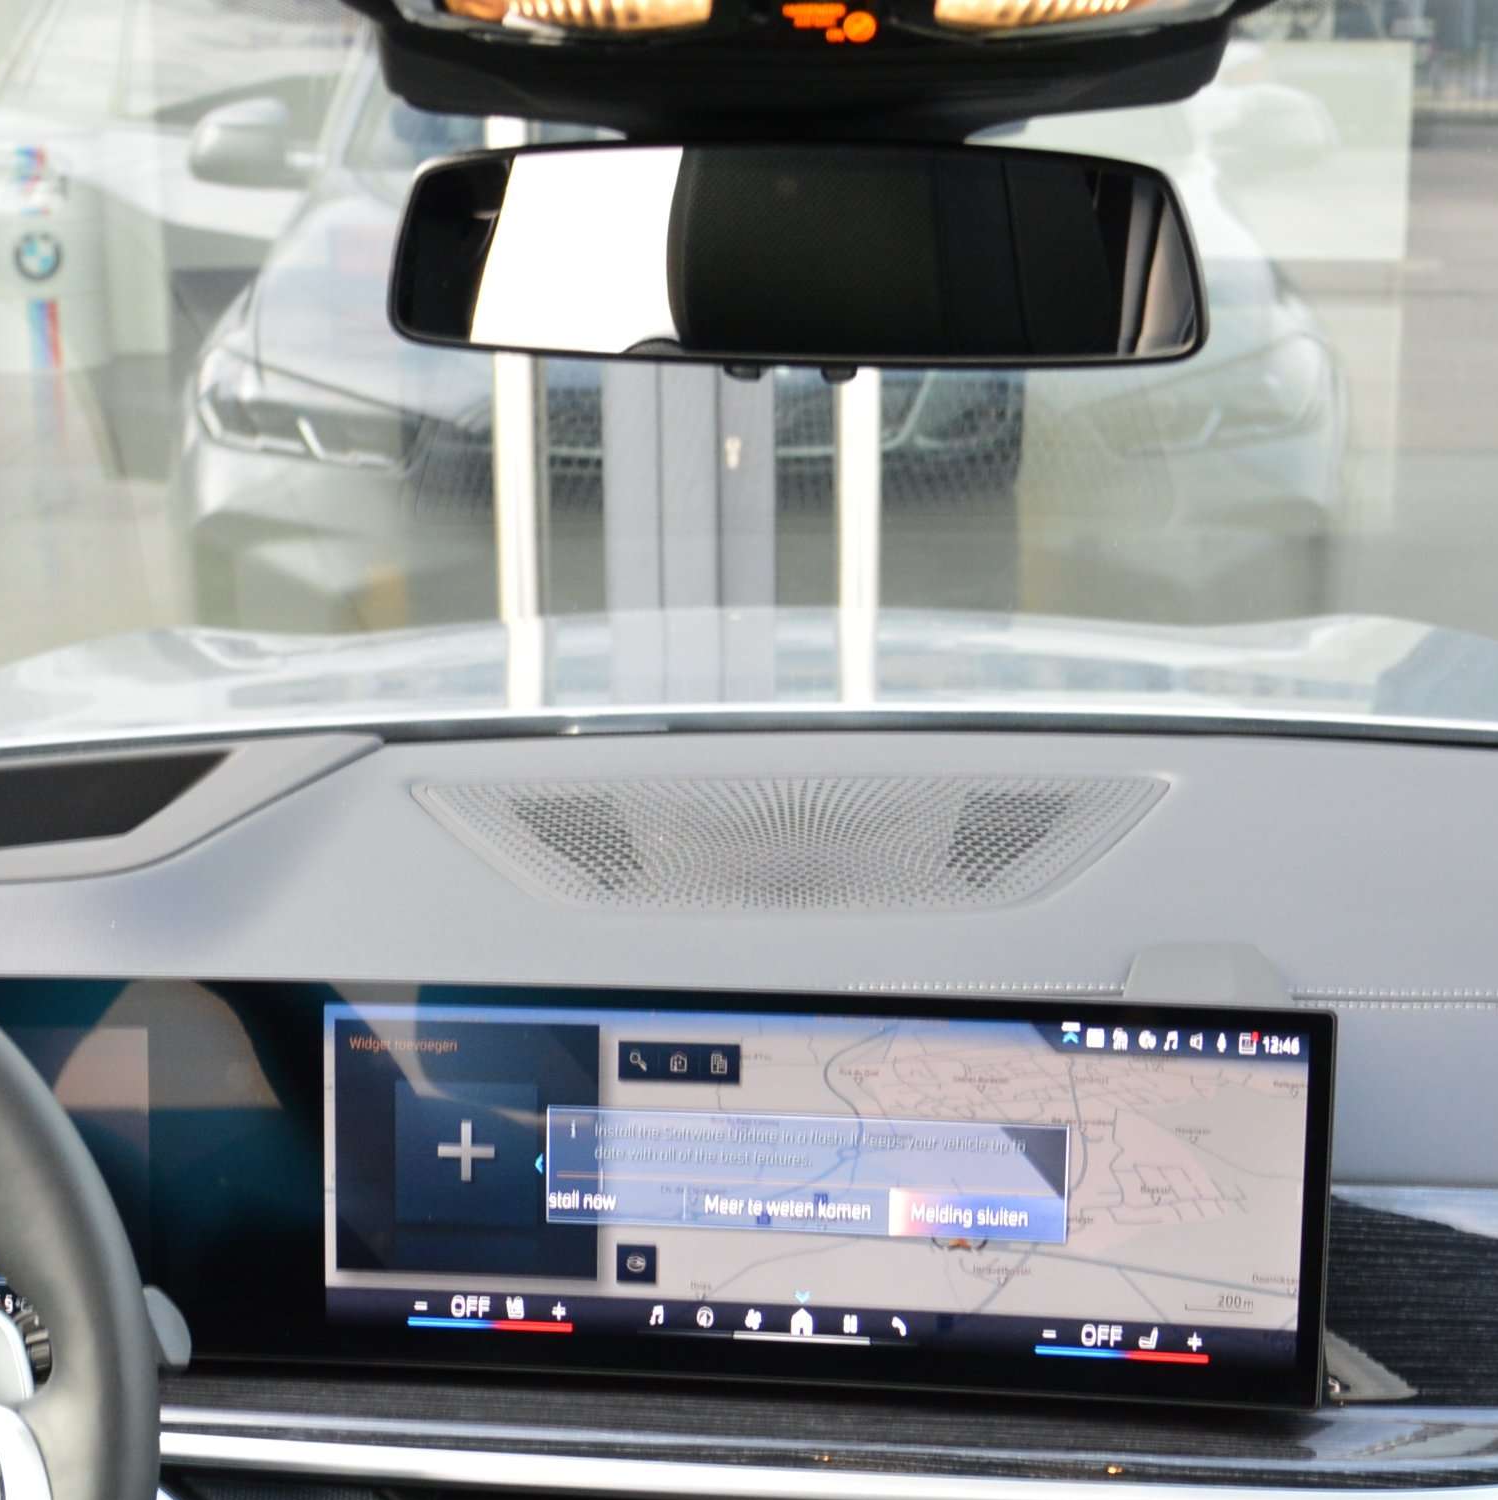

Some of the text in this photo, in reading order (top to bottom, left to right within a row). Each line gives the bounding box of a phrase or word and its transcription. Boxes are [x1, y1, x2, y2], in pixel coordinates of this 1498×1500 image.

[350, 1036, 389, 1052] Widget
[1262, 1034, 1300, 1055] 12:46
[583, 1192, 617, 1211] now
[704, 1193, 872, 1220] Meer te weten komen
[911, 1201, 1029, 1228] Melding sluiten
[451, 1295, 491, 1318] OFF
[1217, 1295, 1242, 1309] 200
[1081, 1323, 1123, 1347] OFF
